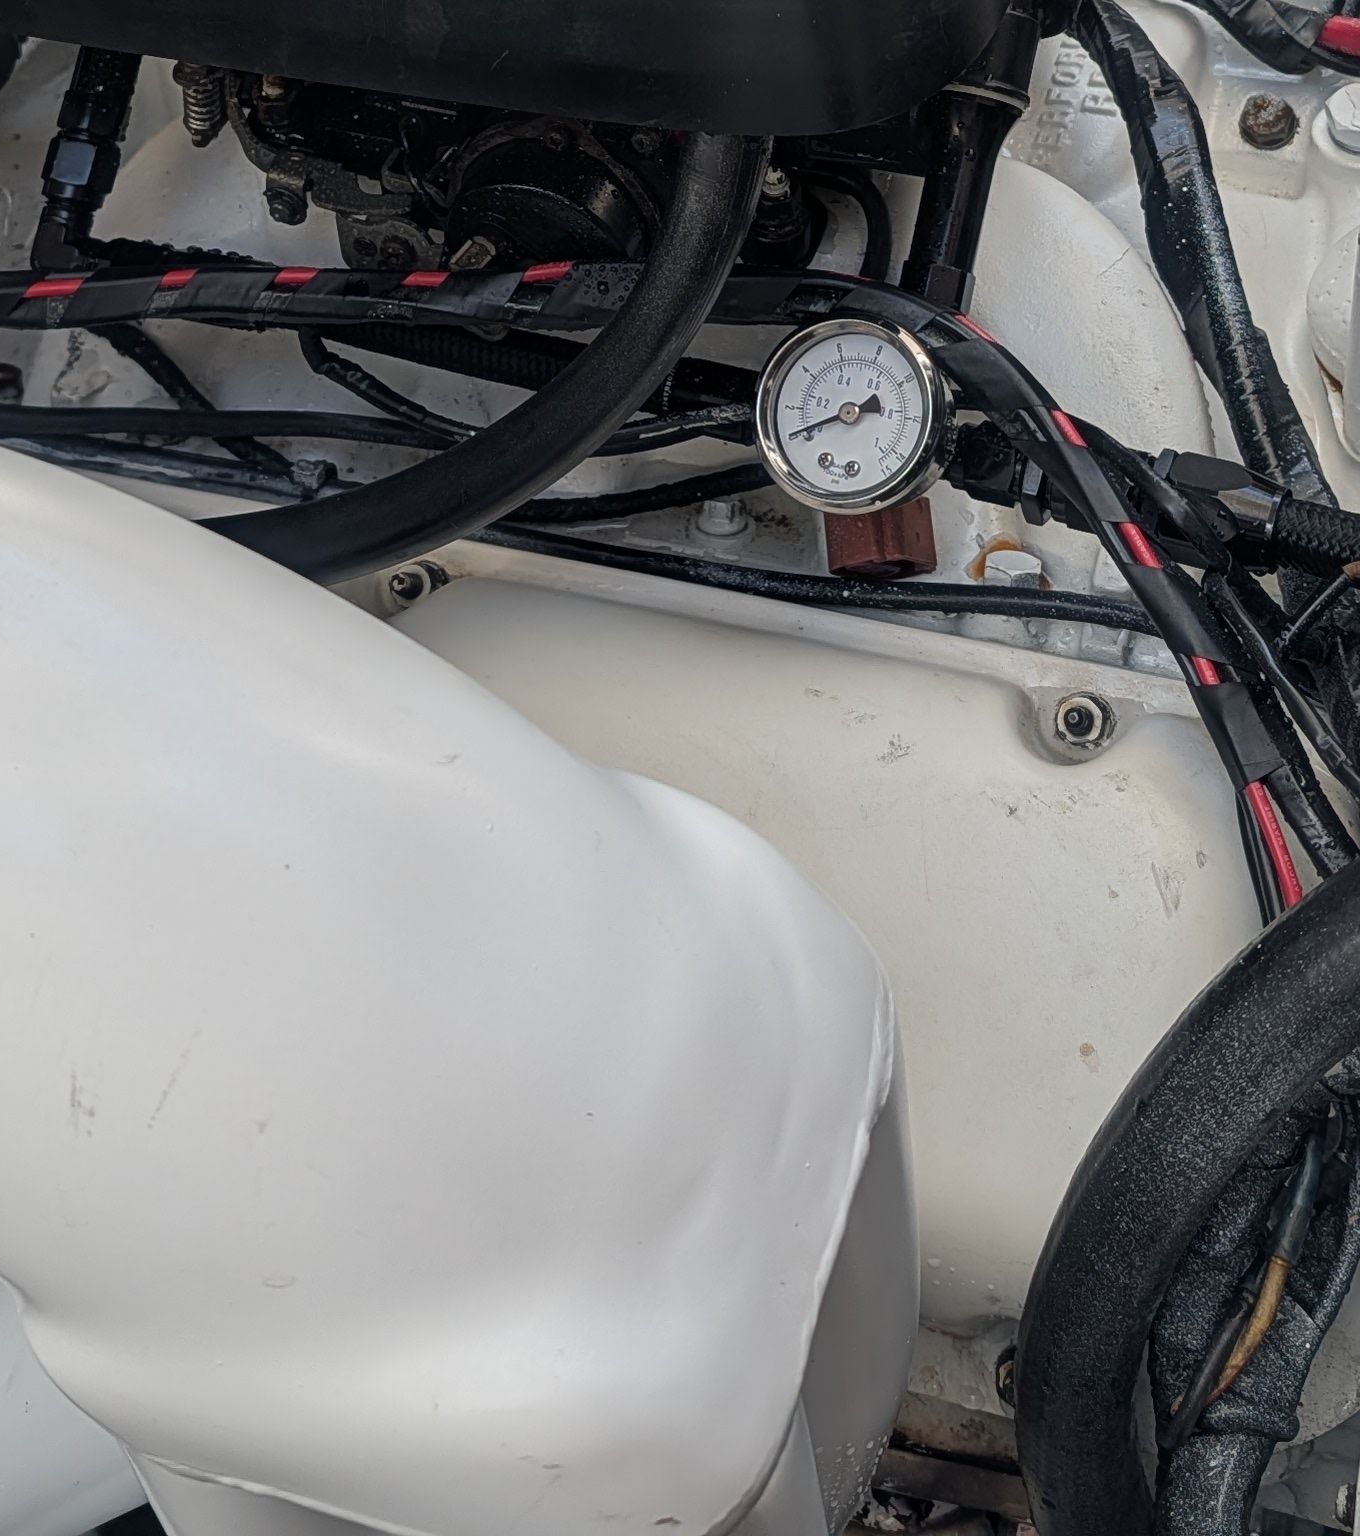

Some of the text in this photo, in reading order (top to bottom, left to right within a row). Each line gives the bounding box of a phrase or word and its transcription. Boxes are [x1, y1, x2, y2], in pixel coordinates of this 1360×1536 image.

[836, 342, 843, 354] 6
[876, 344, 884, 355] 8
[802, 365, 810, 374] 4
[836, 373, 851, 387] 0.4
[903, 371, 914, 384] 10
[866, 377, 881, 391] 0.6
[816, 395, 829, 410] 0.2
[895, 453, 906, 464] 14
[881, 467, 893, 477] 15
[1263, 804, 1285, 848] MARINE
